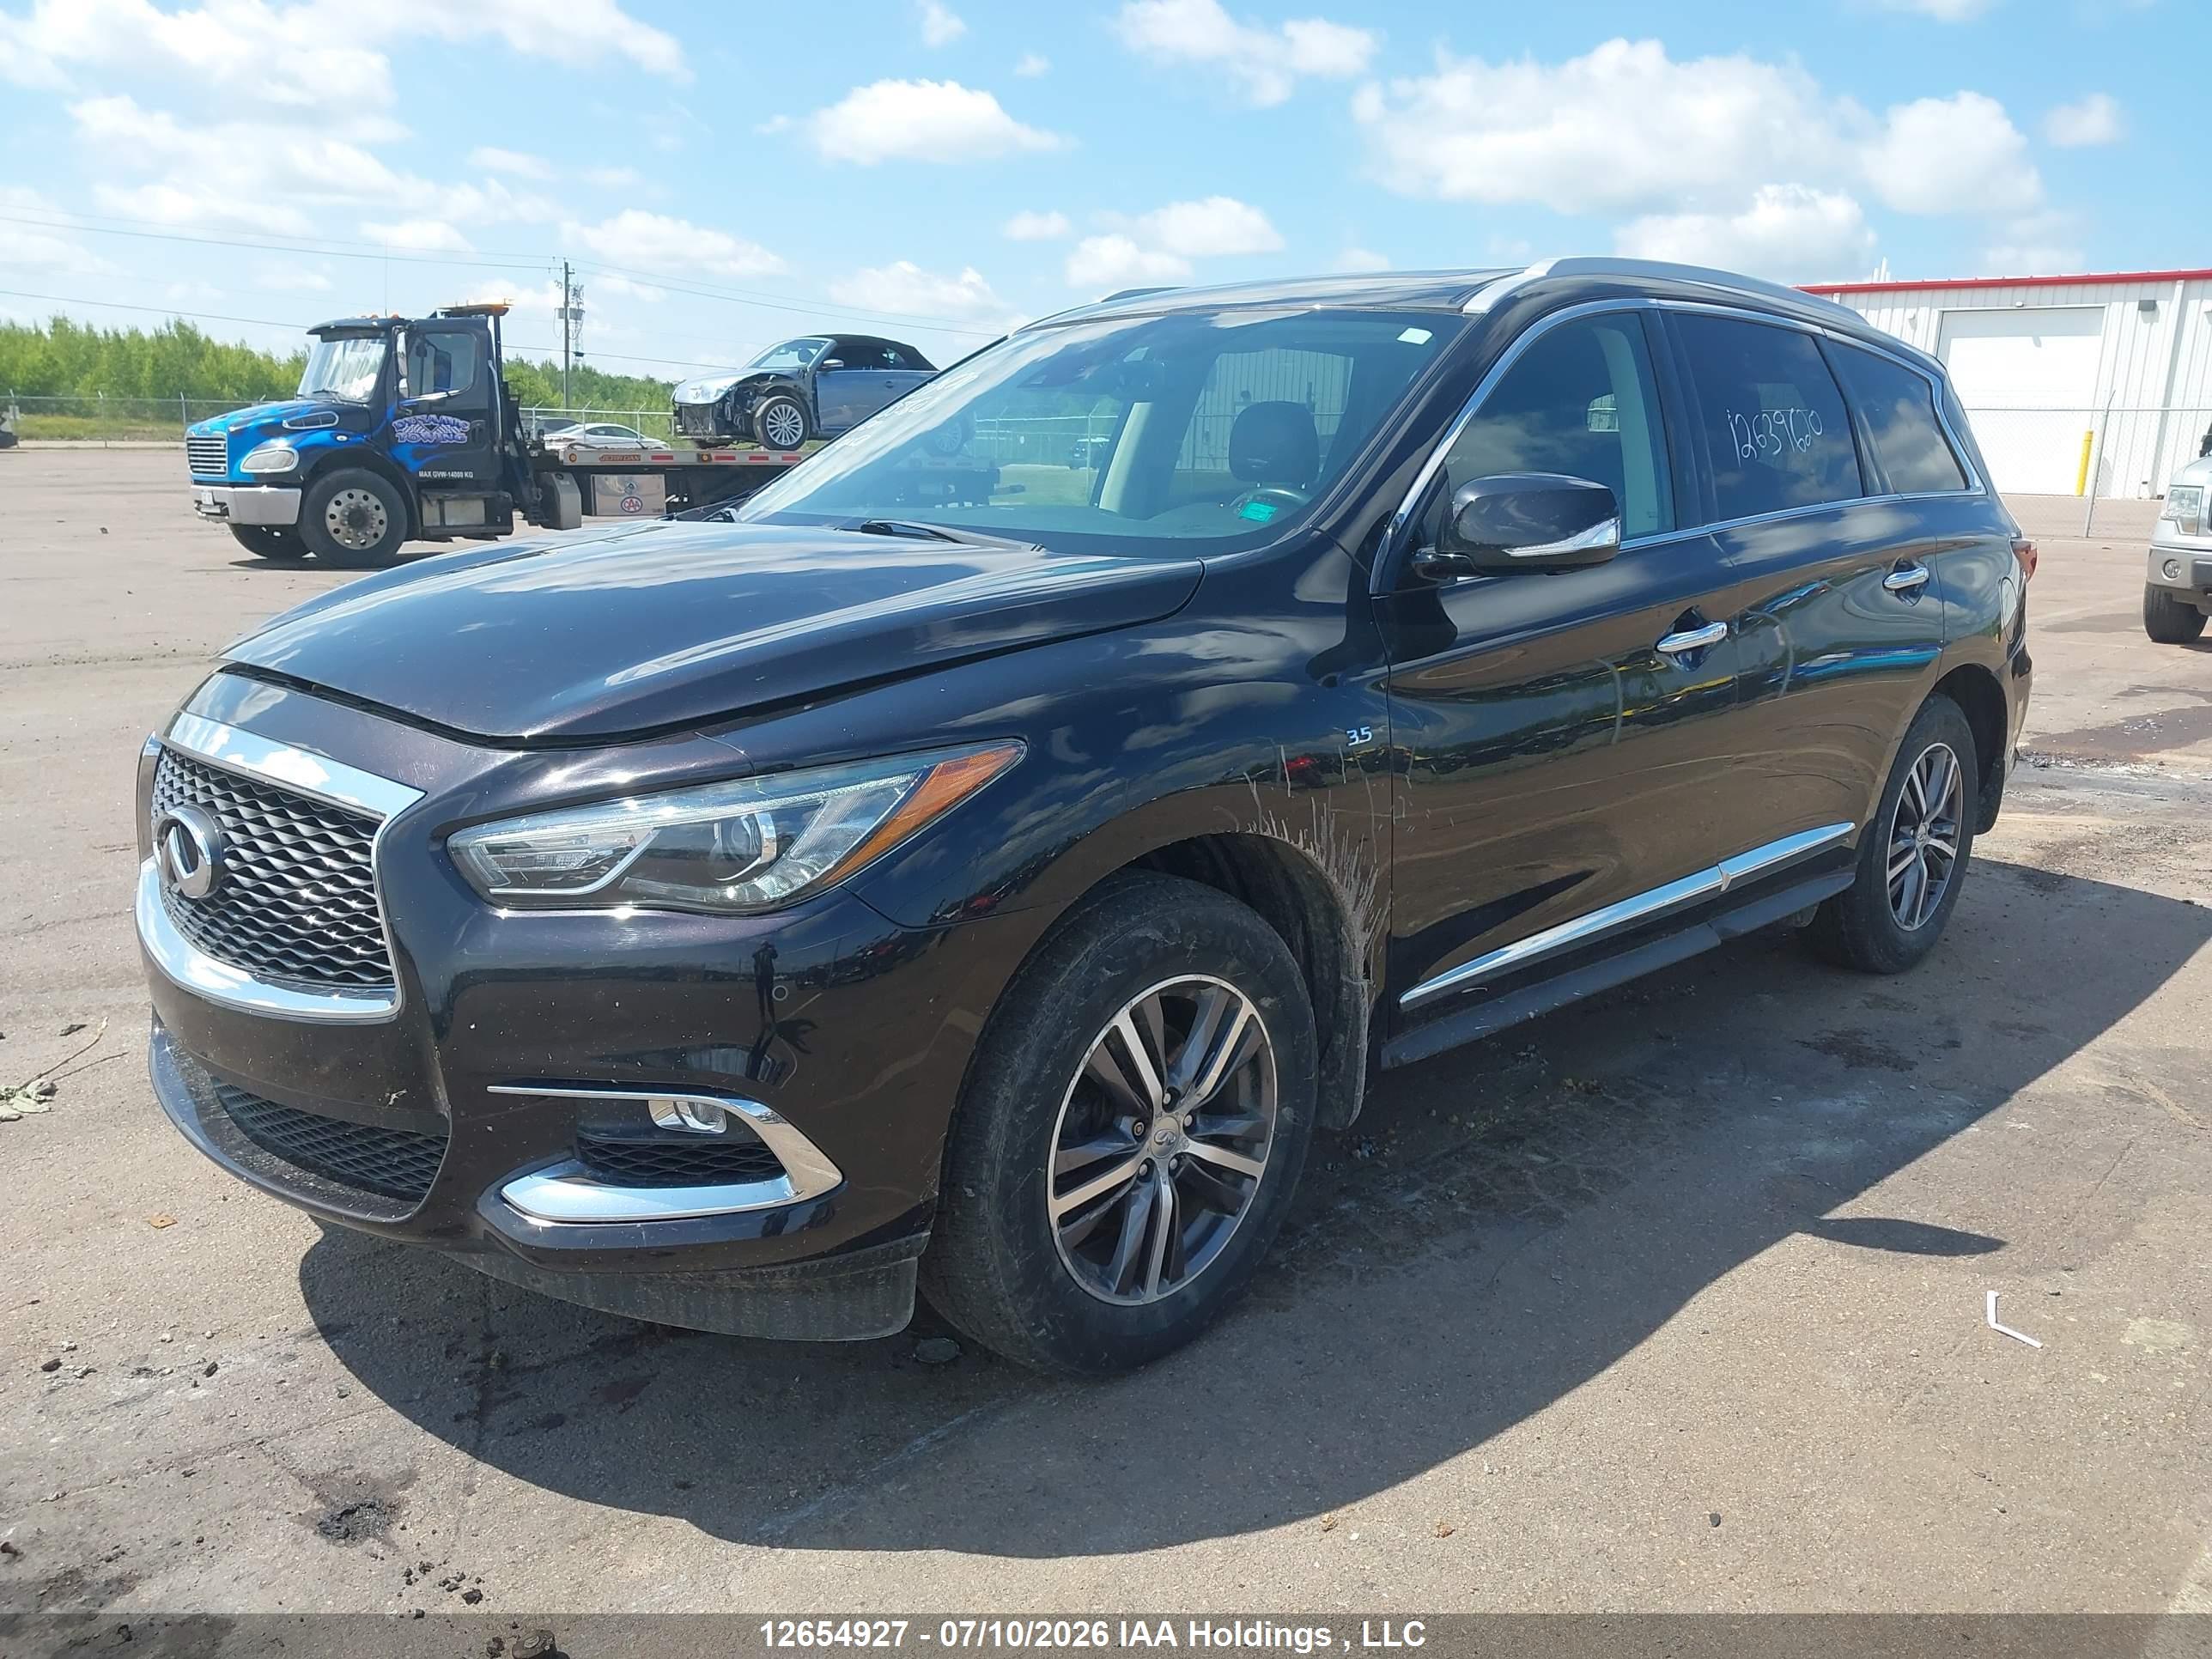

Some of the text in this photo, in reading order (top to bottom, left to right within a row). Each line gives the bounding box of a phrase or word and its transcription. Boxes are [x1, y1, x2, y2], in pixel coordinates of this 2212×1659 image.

[392, 414, 471, 432] DYNAMIC
[395, 431, 468, 444] TOWING
[623, 499, 641, 510] CAA
